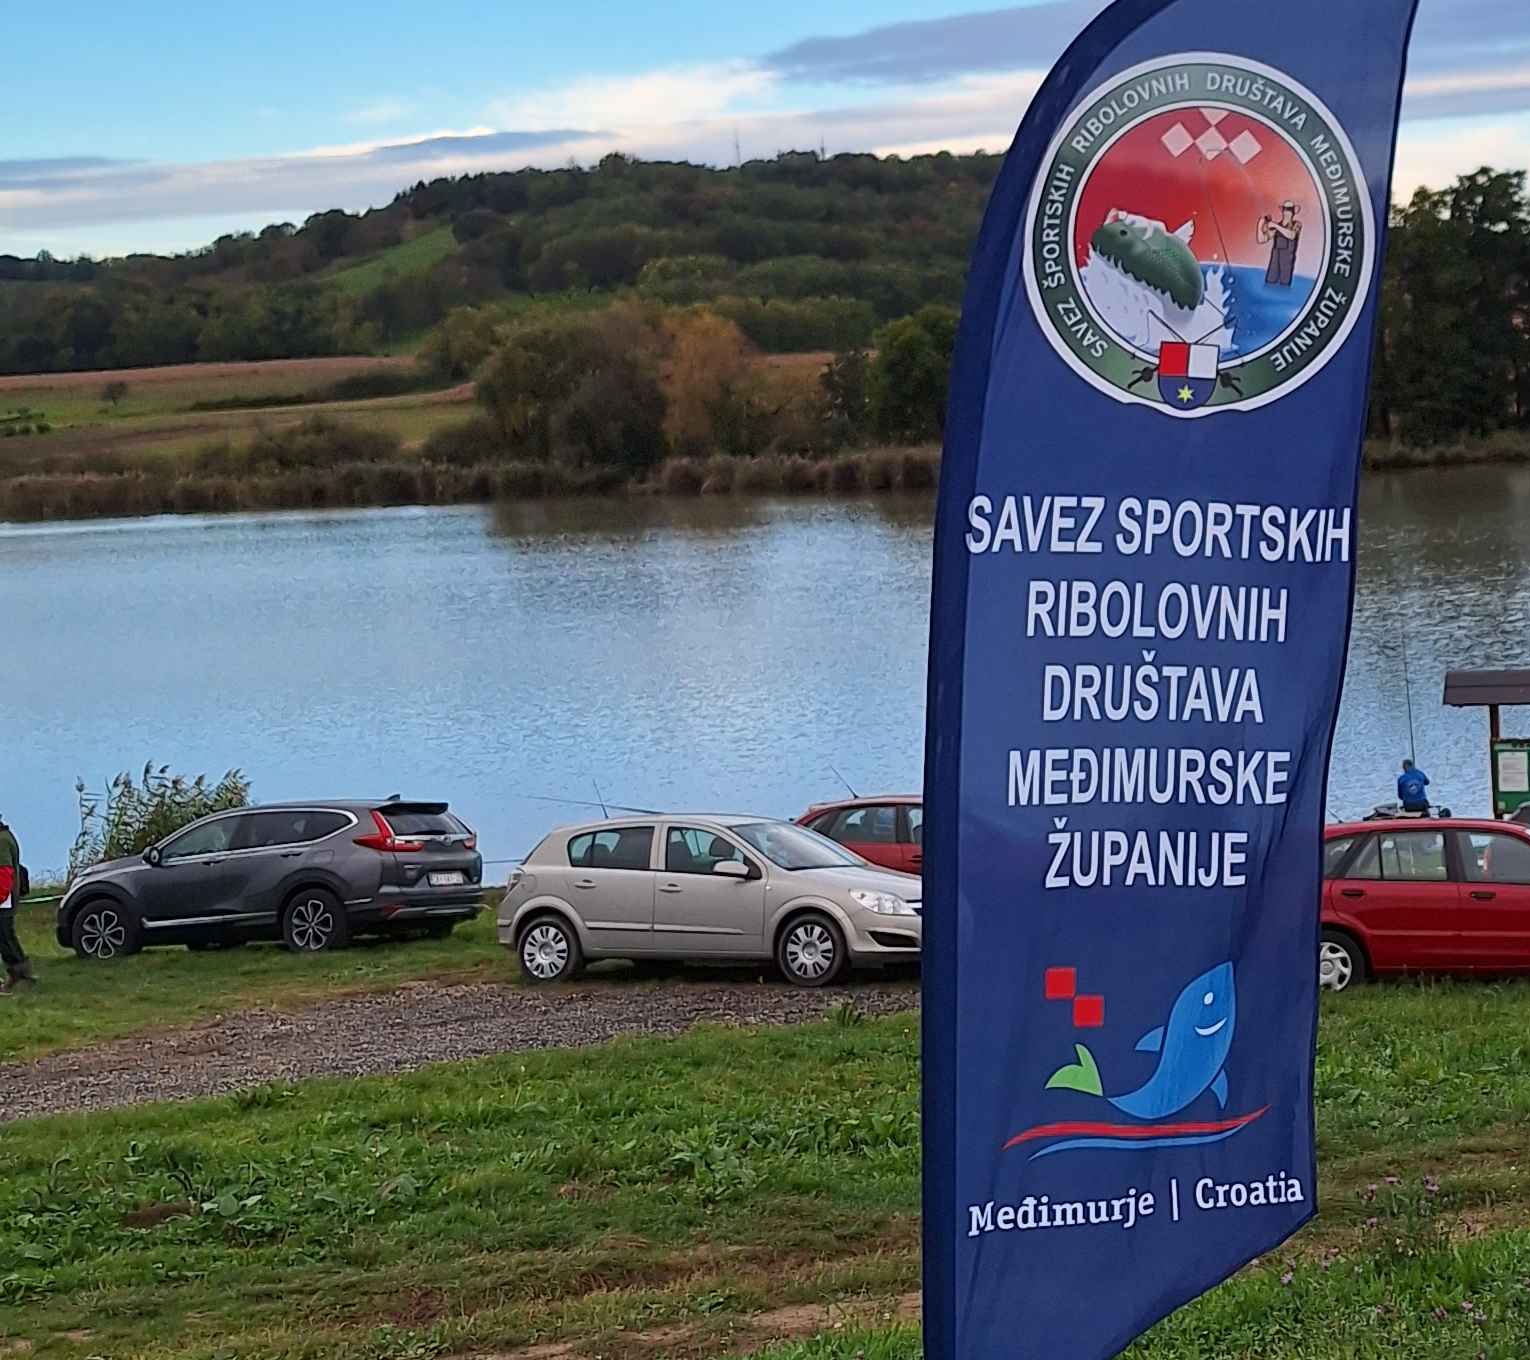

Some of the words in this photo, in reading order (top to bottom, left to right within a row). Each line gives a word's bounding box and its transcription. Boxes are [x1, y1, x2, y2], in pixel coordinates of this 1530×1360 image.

[1071, 72, 1190, 154] RIBOLOVNIH
[1207, 73, 1308, 131] DRUŠTAVA
[1042, 163, 1075, 289] ŠPORTSKIH
[1310, 133, 1354, 278] MEĐIMURSKE
[1056, 297, 1109, 358] SAVEZ
[1270, 287, 1347, 372] ŽUPANIJE
[965, 495, 1106, 554] SAVEZ
[1115, 497, 1351, 563] SPORTSKIH
[1026, 580, 1288, 642] RIBOLOVNIH
[1042, 649, 1264, 723] DRUŠTAVA
[1008, 747, 1291, 807] MEĐIMURSKE
[1045, 817, 1248, 888] ŽUPANIJE
[968, 1188, 1155, 1237] Međimurje
[1195, 1171, 1304, 1210] Croatia
